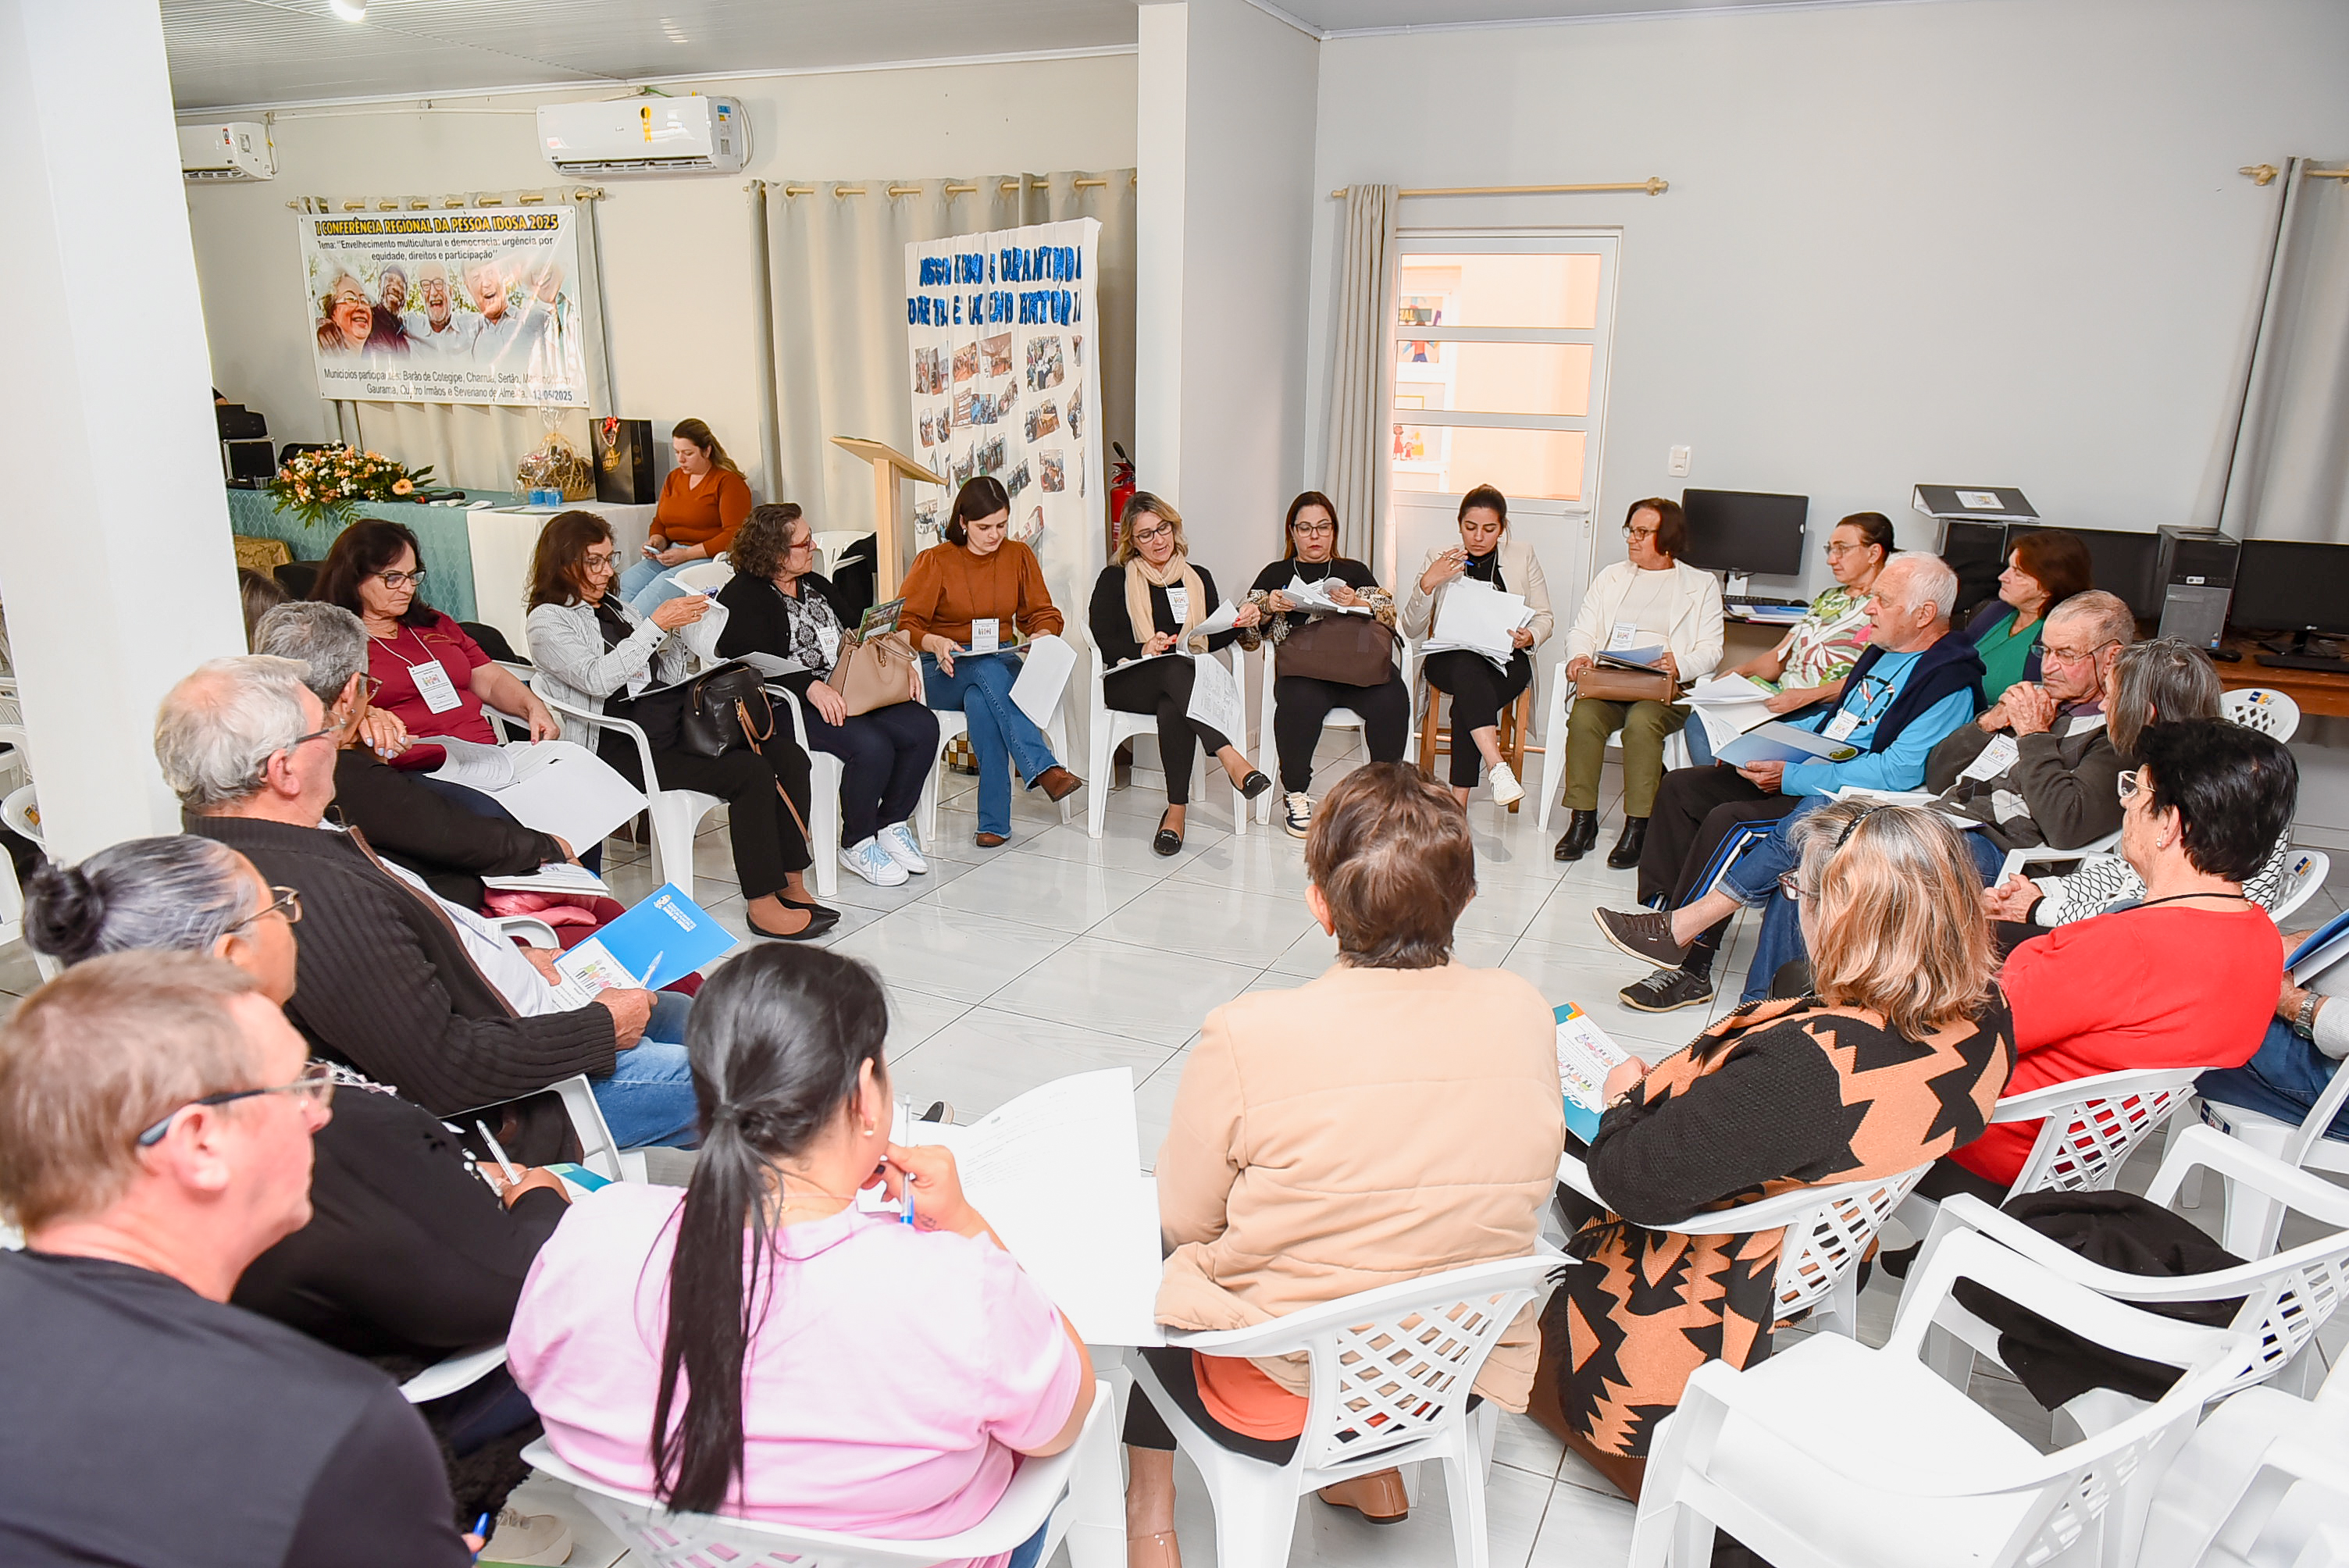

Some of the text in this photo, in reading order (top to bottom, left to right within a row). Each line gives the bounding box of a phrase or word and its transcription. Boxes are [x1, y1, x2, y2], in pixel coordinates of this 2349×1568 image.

[322, 216, 383, 234] CONFERÊNCIA
[383, 218, 432, 234] REGIONAL
[433, 217, 450, 233] DA
[451, 216, 491, 233] PESSOA
[492, 215, 528, 231] IDOSA
[529, 214, 559, 230] 2025
[318, 241, 337, 250] Tema:
[397, 238, 443, 248] multicultural
[502, 236, 536, 248] urgência
[539, 237, 554, 247] por
[372, 251, 407, 262] equidade,
[408, 251, 437, 260] direitos
[323, 368, 357, 381] Municípios
[403, 370, 422, 381] Barão
[423, 372, 431, 381] de
[433, 371, 465, 384] Cotegipe,
[497, 372, 521, 384] Sertão,
[366, 383, 398, 395] Gaurama,
[401, 384, 422, 396] Qutro
[424, 385, 446, 397] Irmãos
[454, 387, 487, 397] Severiano
[489, 387, 497, 397] de
